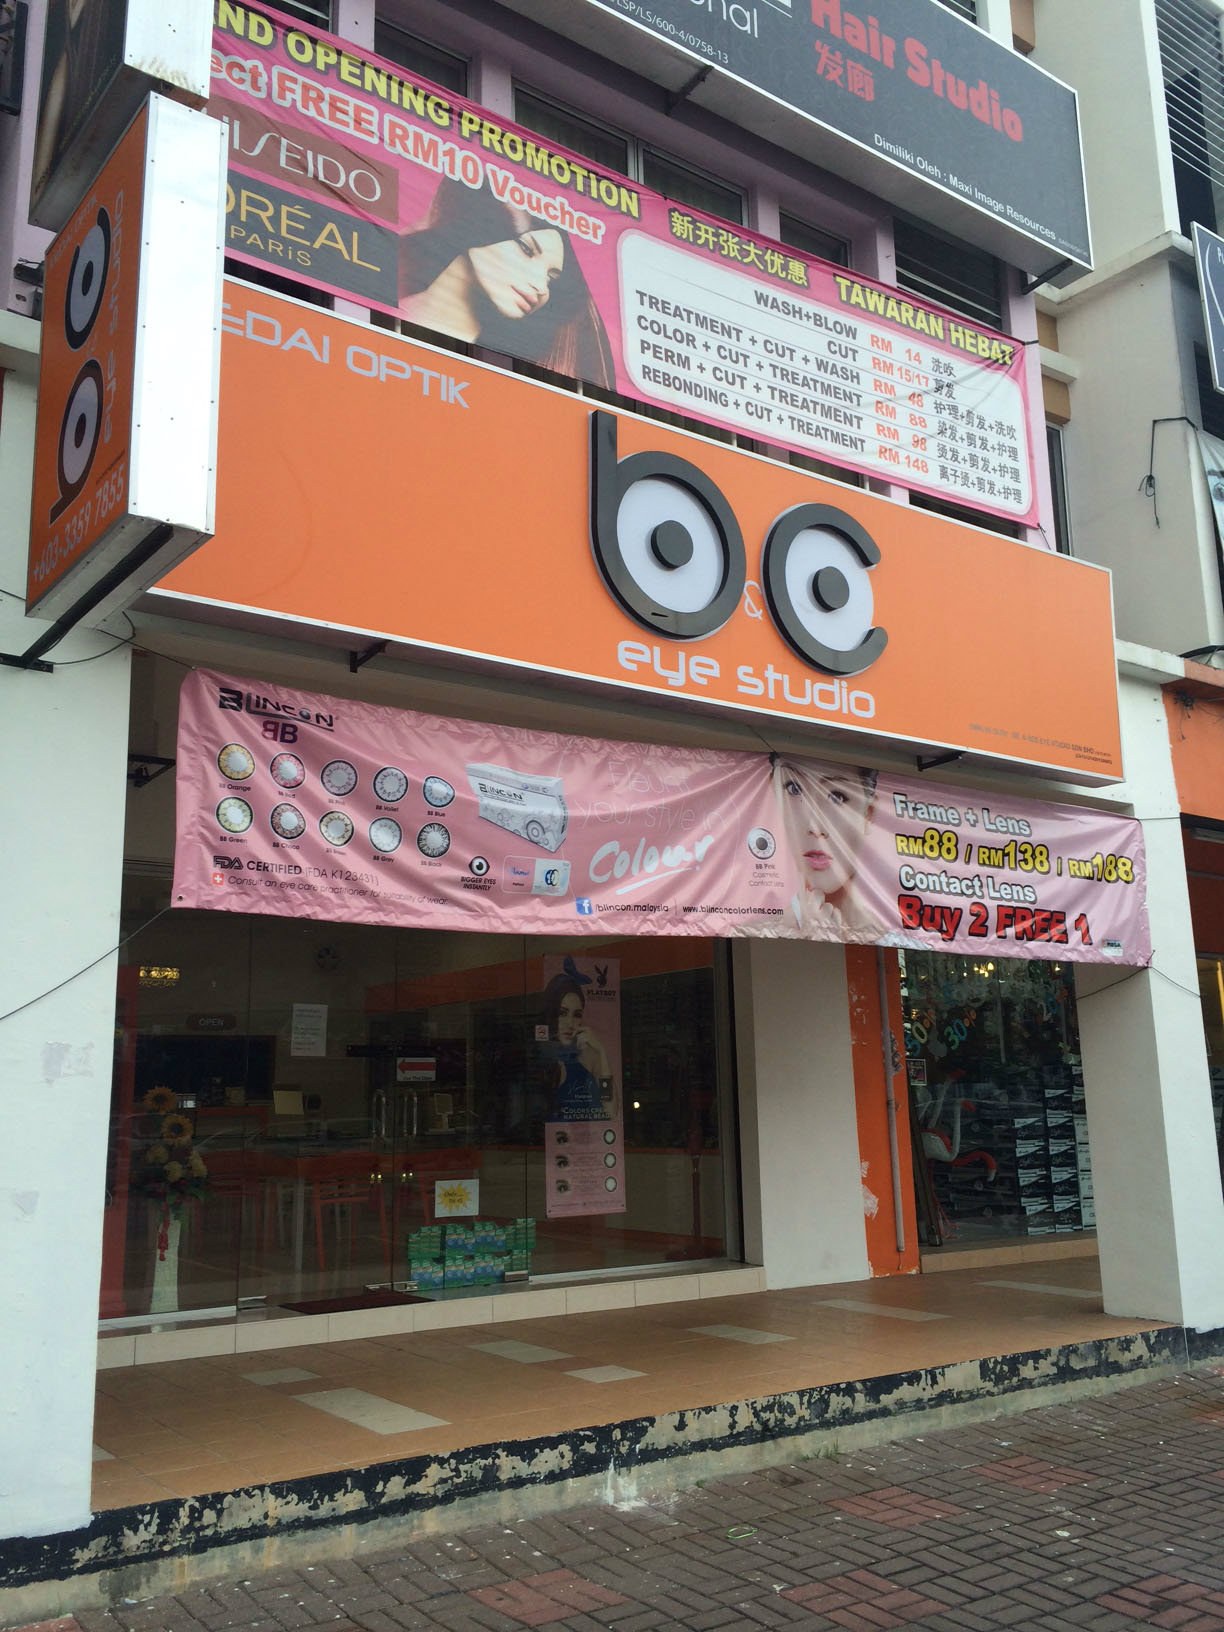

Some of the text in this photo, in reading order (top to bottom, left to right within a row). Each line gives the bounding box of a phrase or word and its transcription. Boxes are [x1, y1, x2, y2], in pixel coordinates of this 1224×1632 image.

[811, 0, 1024, 143] Hair Studio
[213, 2, 640, 218] ND OPENING PROMOTION
[276, 71, 376, 139] FREE
[388, 119, 480, 186] RM10
[490, 168, 603, 241] Voucher
[873, 132, 915, 164] Dimiliki
[916, 156, 942, 179] Oleh
[949, 173, 973, 196] Maxi
[974, 186, 1005, 215] Image
[1005, 204, 1057, 242] Resources
[671, 210, 808, 287] 新开张大优惠
[636, 289, 743, 343] TREATMENT
[763, 338, 796, 363] CUT
[815, 356, 861, 386] WASH
[873, 378, 896, 398] RM
[908, 391, 925, 409] 48
[835, 275, 1015, 366] TAWARAN HEBAT
[870, 333, 893, 354] RM
[905, 348, 923, 366] 14
[346, 345, 471, 410] OPTIK
[637, 314, 698, 351] COLOR
[717, 344, 750, 369] CUT
[769, 362, 863, 408] TREATMENT
[874, 400, 897, 420] RM
[909, 412, 928, 430] 88
[640, 339, 691, 372] PERM
[712, 366, 747, 391] CUT
[767, 385, 864, 430] TREATMENT
[876, 422, 899, 442] RM
[911, 433, 928, 452] 98
[827, 339, 930, 389] CUT RM 15/17
[642, 364, 729, 408] REBONDING
[745, 400, 773, 424] CUT
[788, 414, 867, 453] TREATMENT
[878, 445, 901, 465] RM
[905, 455, 929, 474] 148
[617, 640, 876, 719] eye studio
[892, 792, 961, 826] Frame
[982, 807, 1033, 837] Lens
[213, 855, 244, 871] FDA
[246, 860, 302, 875] CERTIFIED
[279, 881, 296, 891] eye
[483, 878, 497, 886] EYES
[588, 834, 715, 884] Colour
[894, 827, 959, 862] RM88
[977, 839, 1050, 874] RM138
[1068, 852, 1136, 884] RM188
[899, 864, 1037, 904] Contact Lens
[897, 893, 1094, 946] Buy 2 FREE 1
